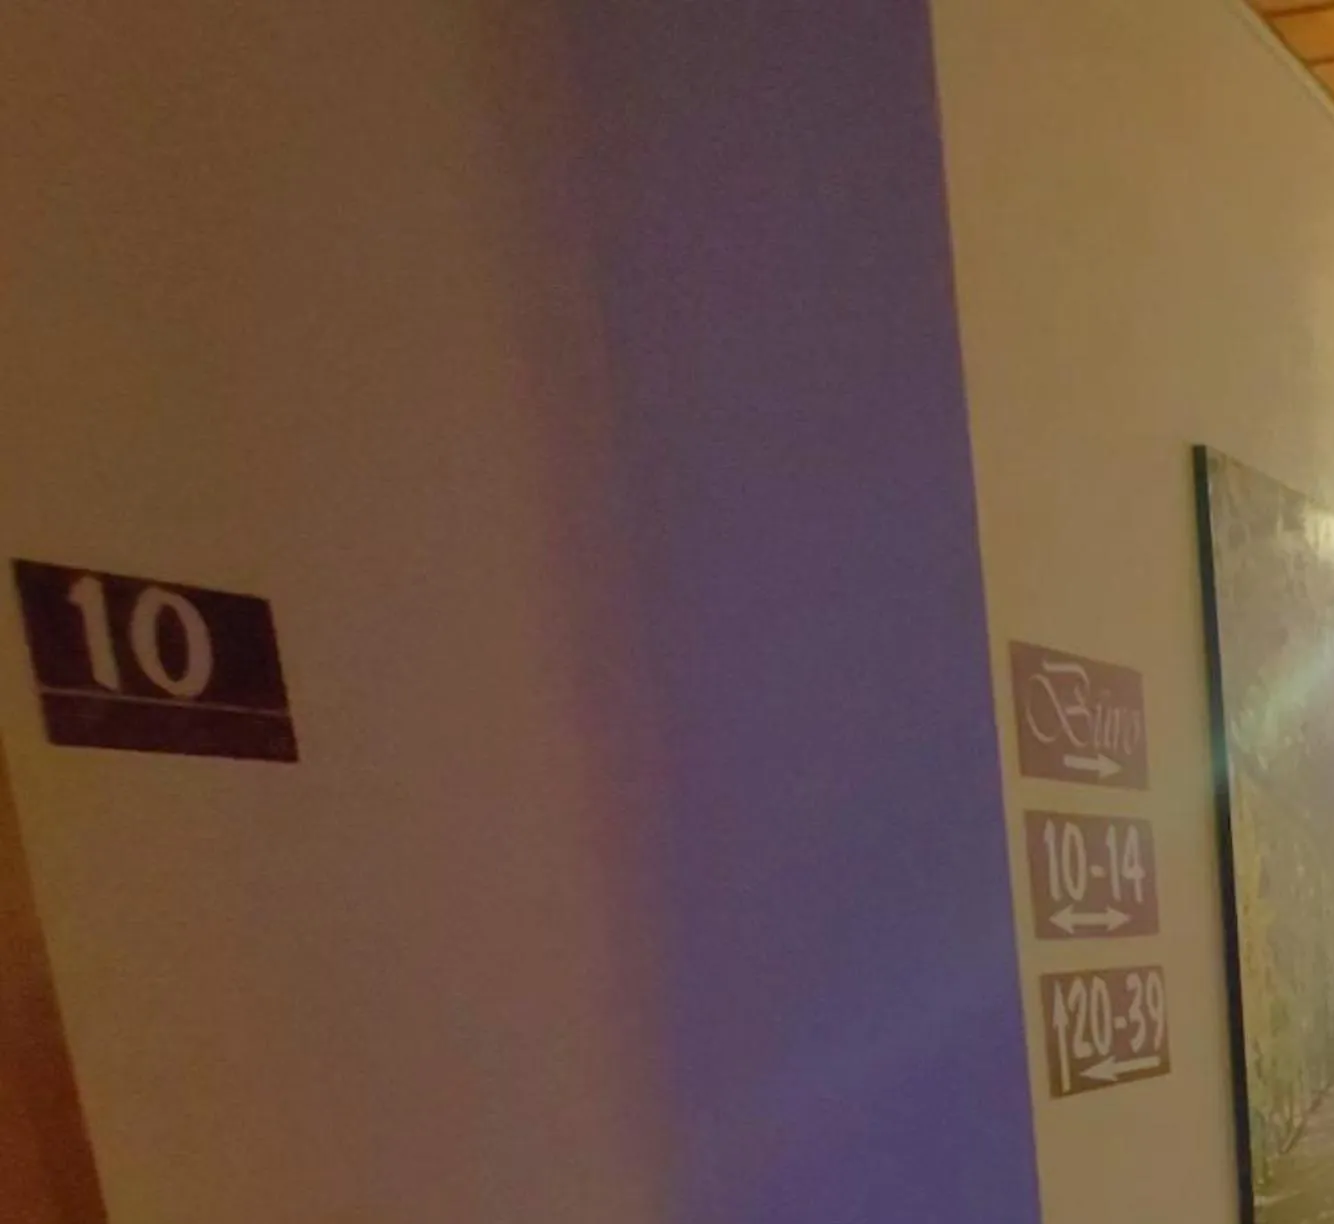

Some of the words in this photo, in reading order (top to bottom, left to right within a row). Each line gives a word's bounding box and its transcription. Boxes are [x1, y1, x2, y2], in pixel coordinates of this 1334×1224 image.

[68, 574, 213, 698] 10
[1043, 818, 1146, 902] 10-14
[1067, 971, 1164, 1059] 20-39
